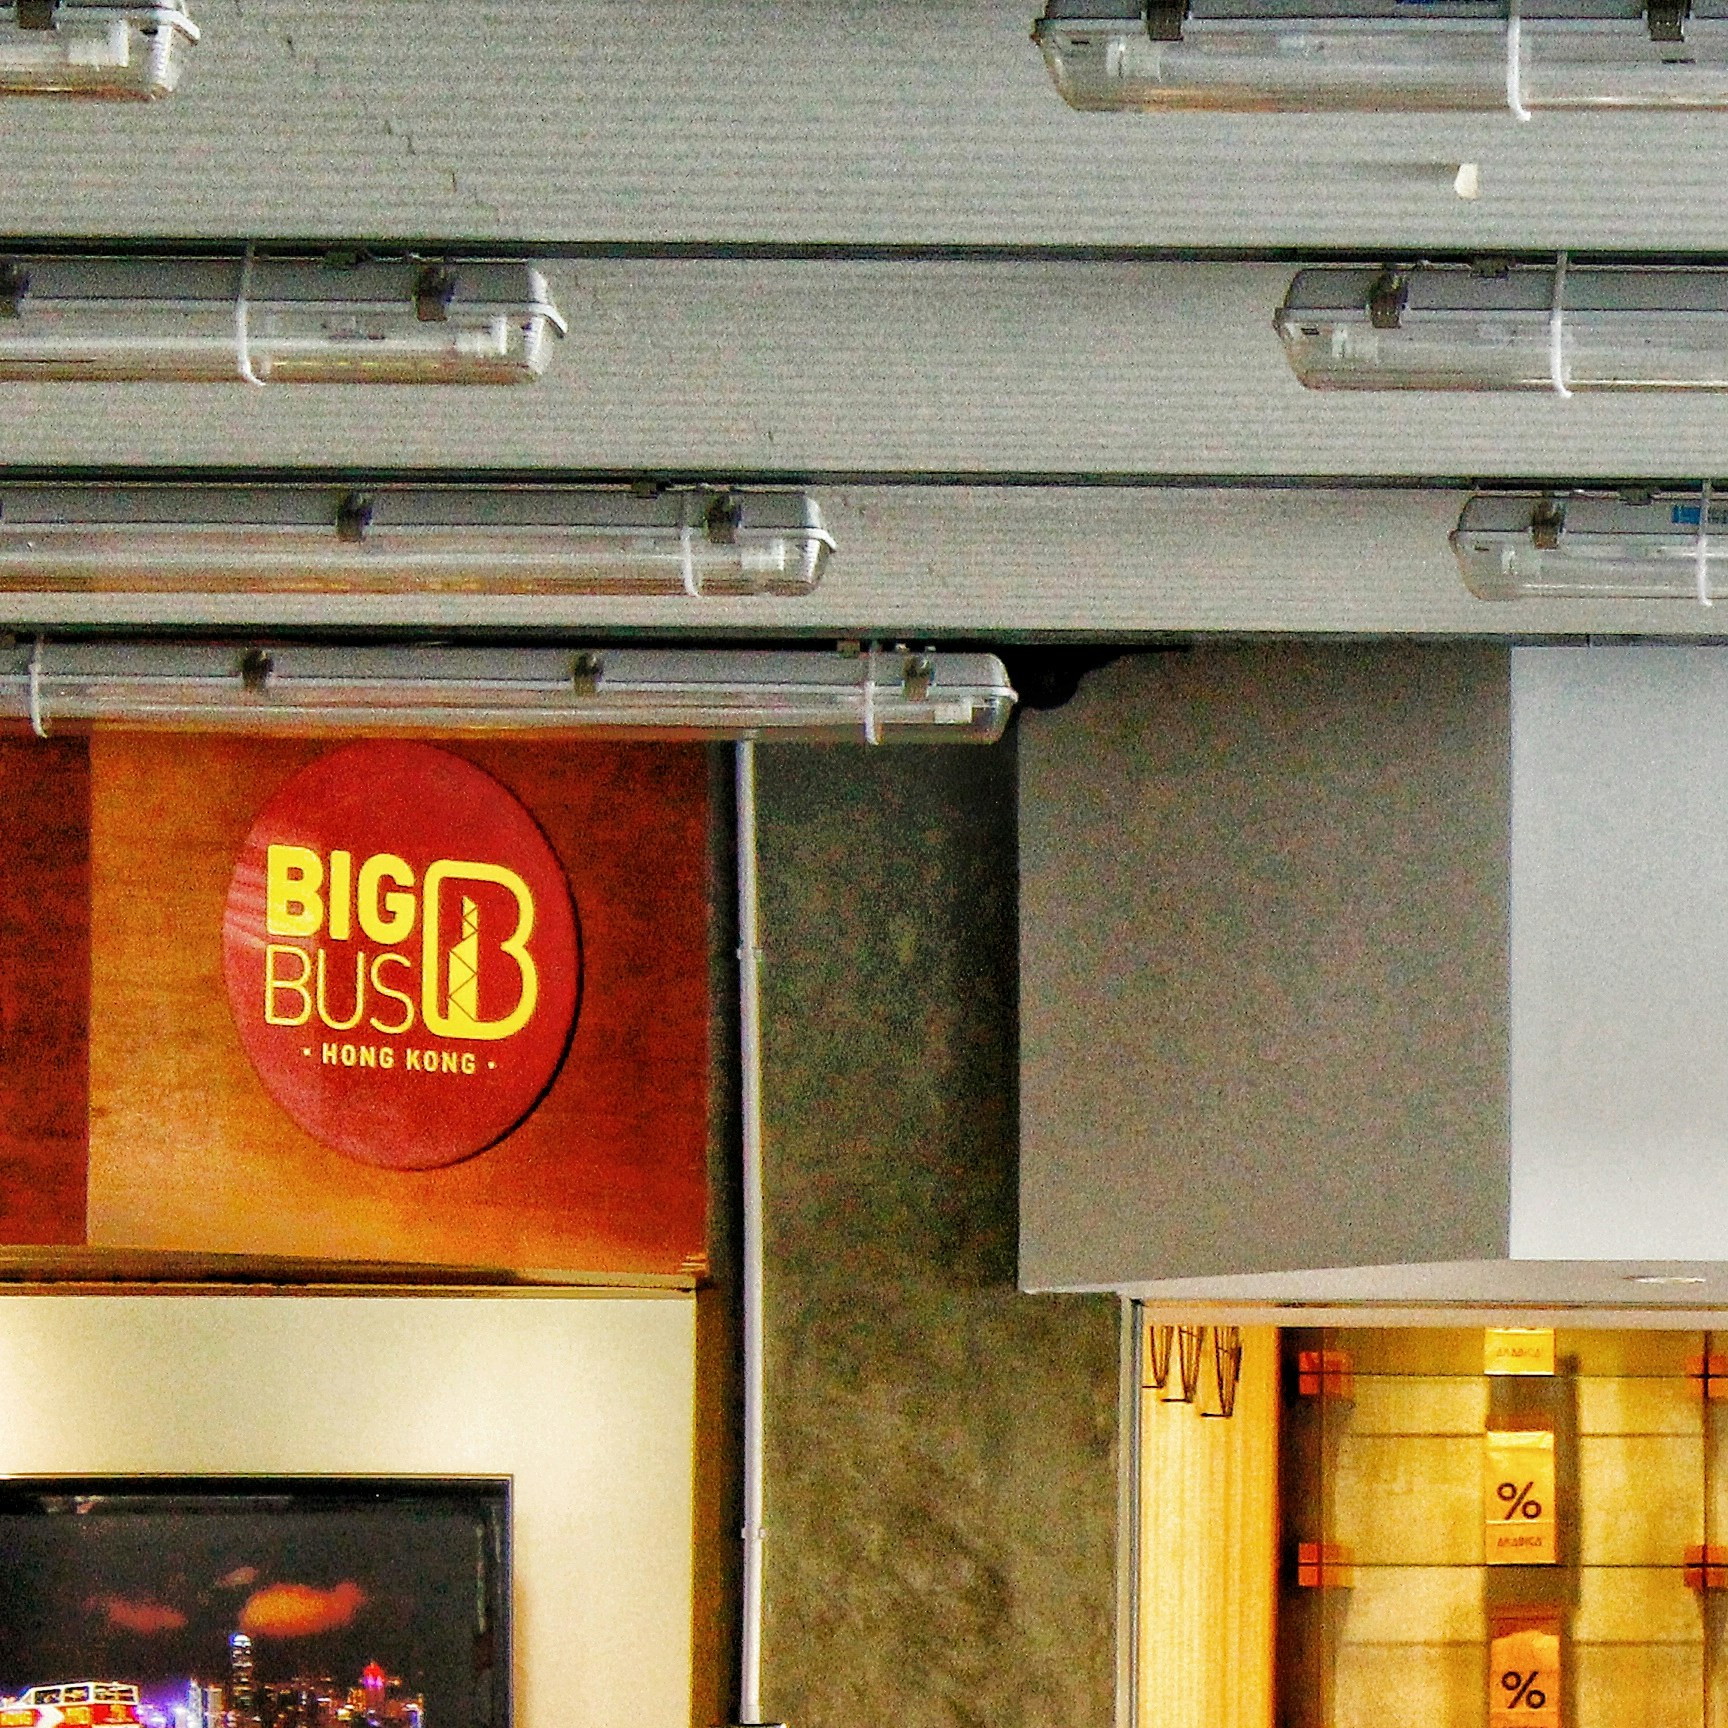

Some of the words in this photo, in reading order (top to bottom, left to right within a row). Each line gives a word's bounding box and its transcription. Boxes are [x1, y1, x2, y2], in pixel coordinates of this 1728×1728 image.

[266, 844, 415, 946] BIG
[263, 944, 414, 1036] BUS
[321, 1042, 395, 1070] HONG
[406, 1047, 477, 1075] KONG
[1497, 1481, 1542, 1520] %
[1501, 1670, 1546, 1710] %
